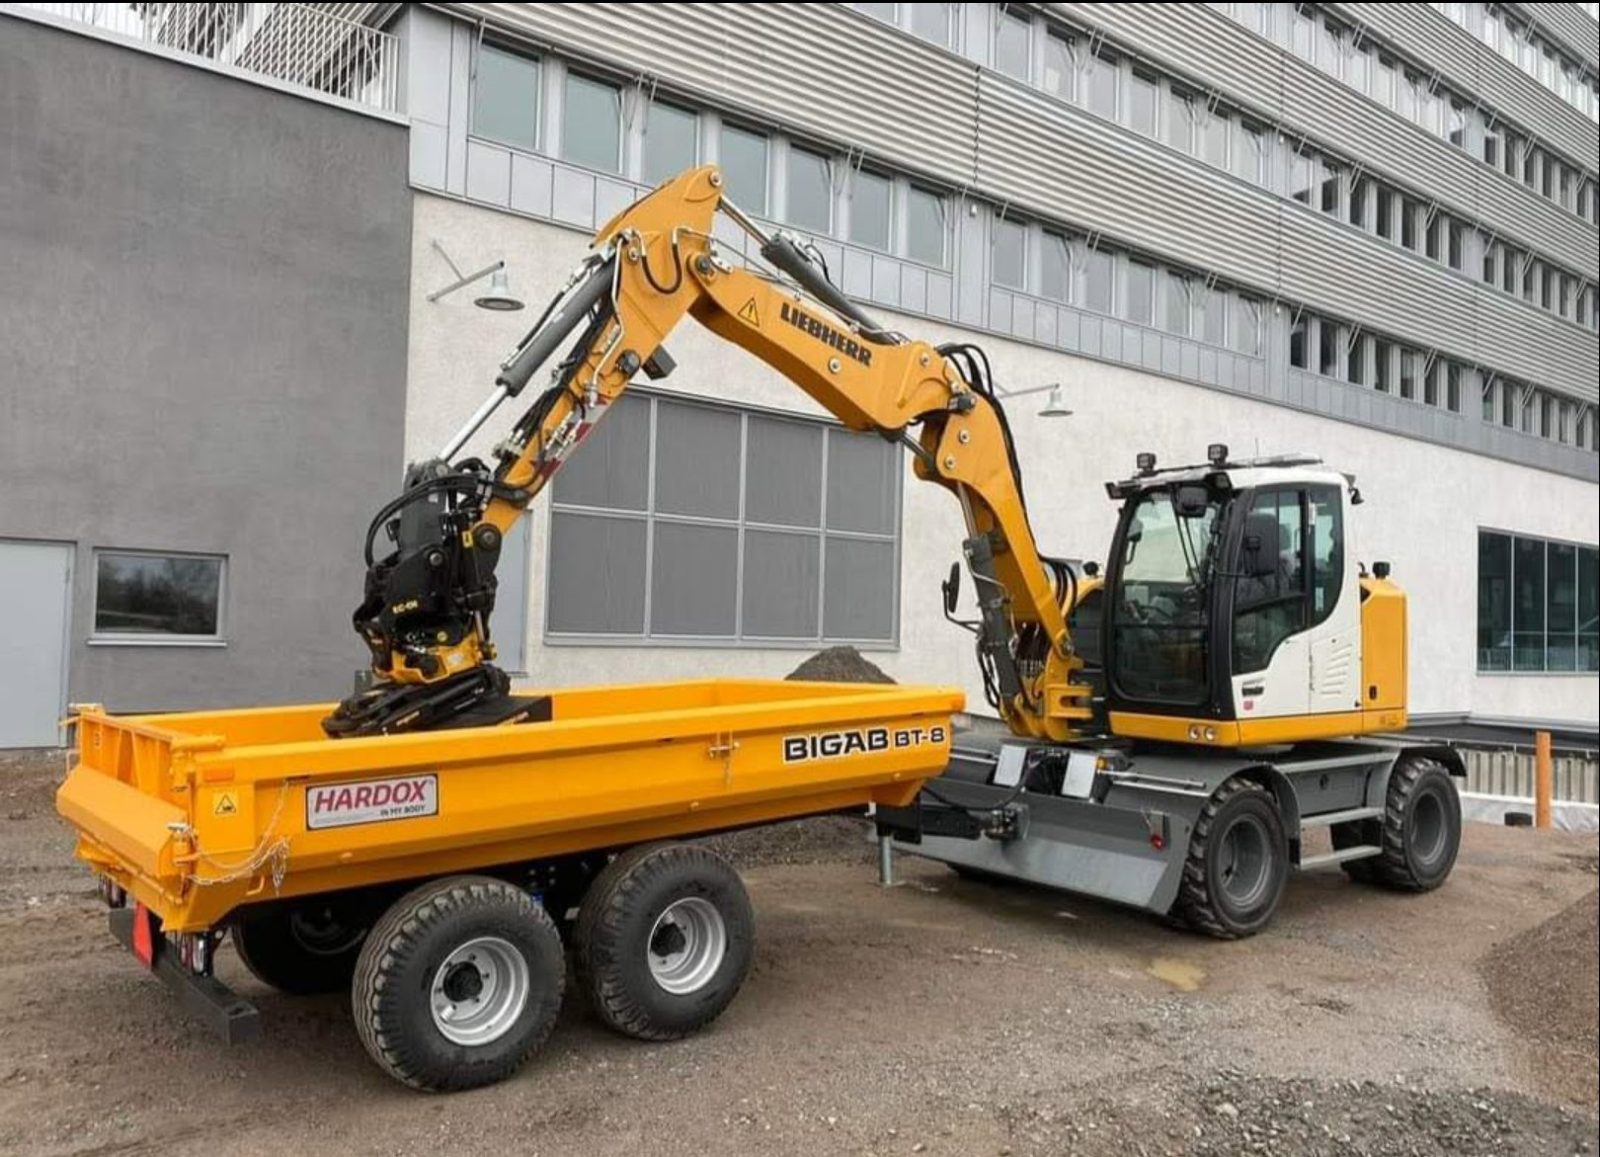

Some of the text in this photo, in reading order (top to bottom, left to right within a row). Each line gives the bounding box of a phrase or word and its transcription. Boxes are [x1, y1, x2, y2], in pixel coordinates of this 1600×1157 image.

[780, 302, 872, 368] LIEBHERR
[784, 727, 945, 762] BIGAB BT-8
[314, 779, 427, 813] HARDOX
[390, 807, 402, 815] MY
[404, 804, 425, 813] BODY
